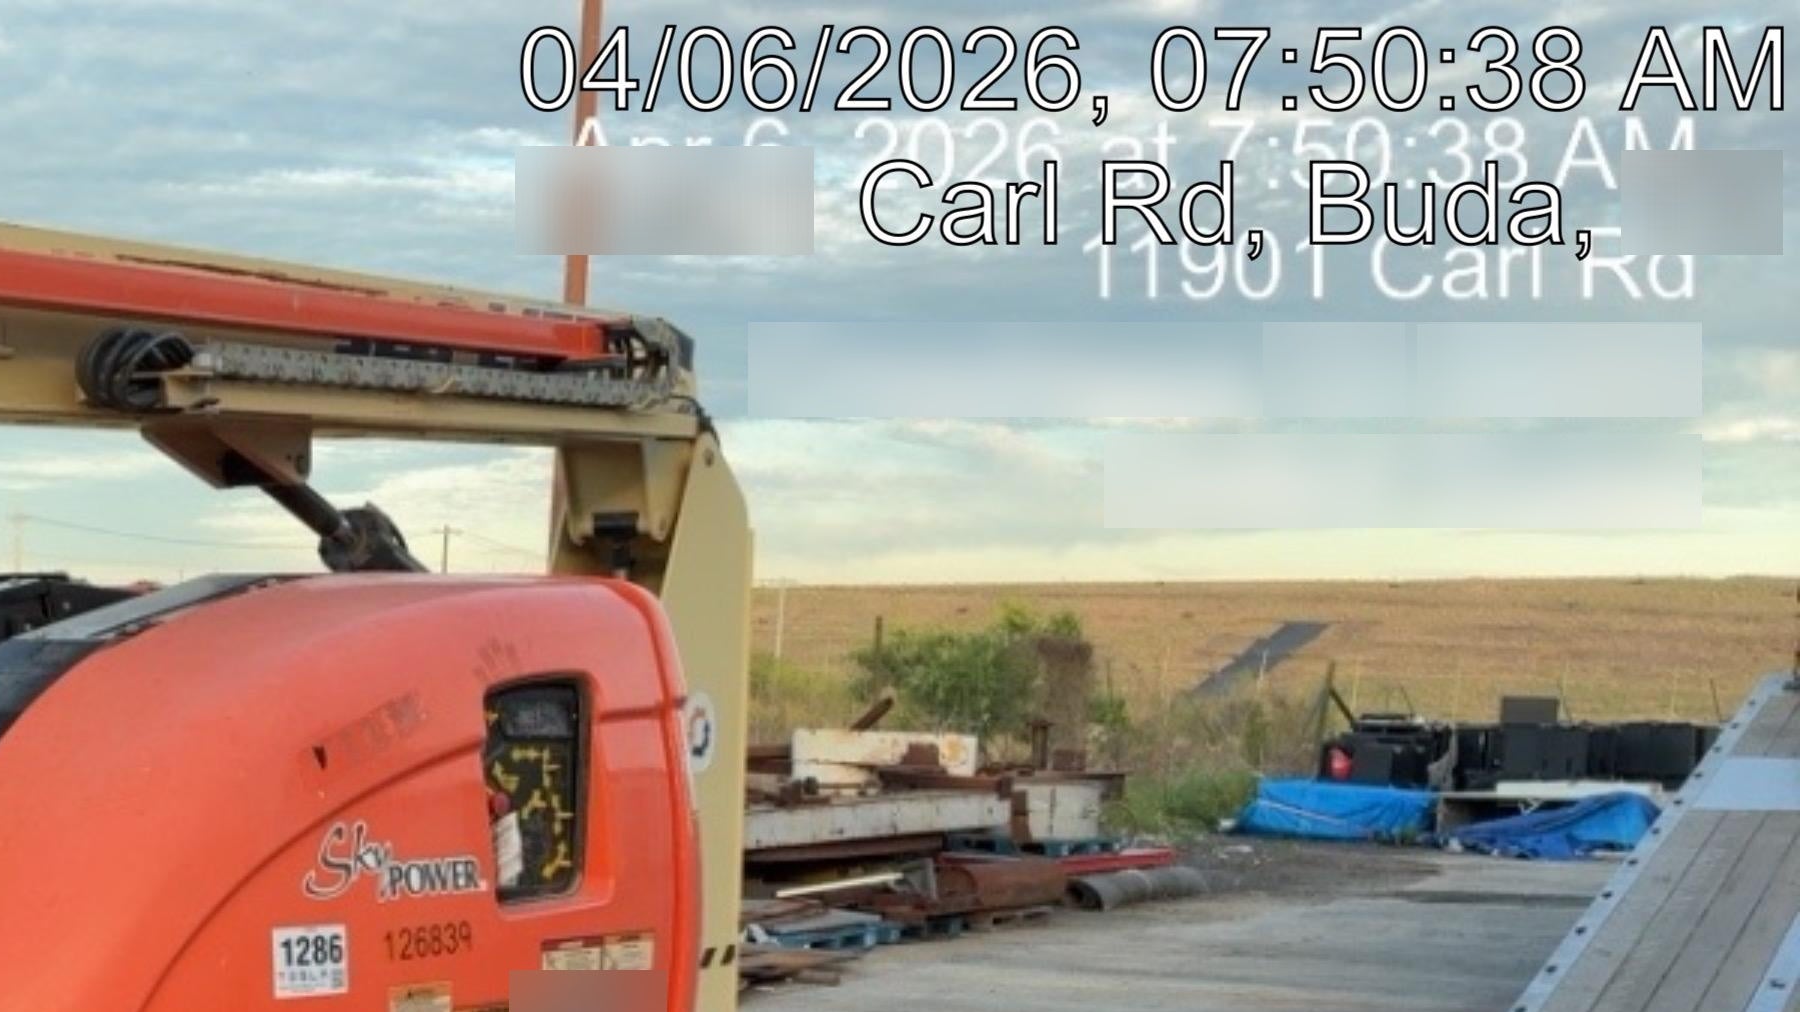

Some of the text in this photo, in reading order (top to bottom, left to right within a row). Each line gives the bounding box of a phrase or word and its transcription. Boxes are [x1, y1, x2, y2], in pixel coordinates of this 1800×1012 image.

[304, 821, 482, 903] Sky POWER
[279, 933, 344, 967] 1286
[383, 919, 473, 962] 126839
